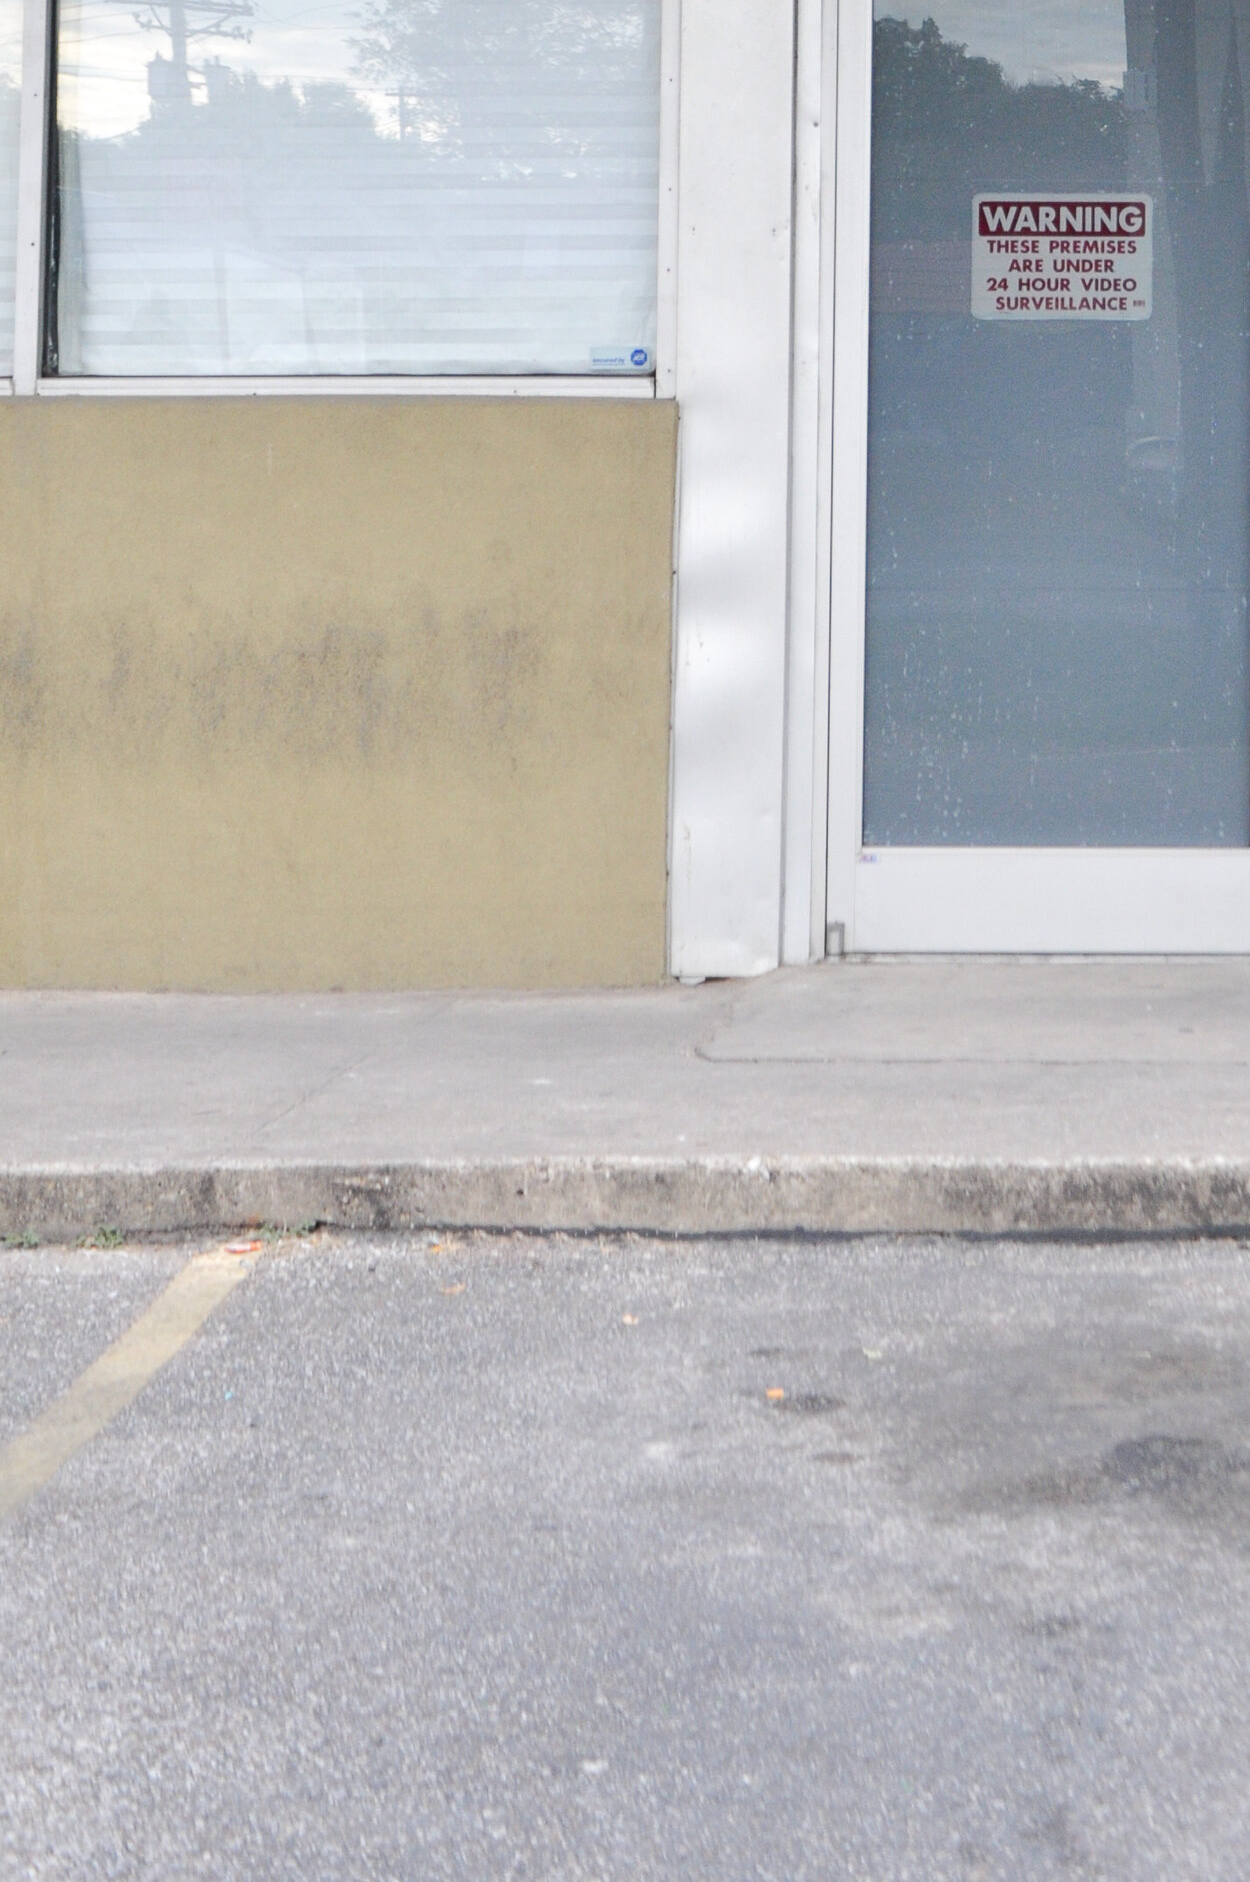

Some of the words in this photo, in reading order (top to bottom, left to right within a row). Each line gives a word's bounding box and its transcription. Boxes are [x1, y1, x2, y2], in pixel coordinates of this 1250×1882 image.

[982, 206, 1143, 233] WARNING
[987, 239, 1040, 254] THESE
[1049, 239, 1137, 254] PREMISES
[1008, 258, 1044, 273] ARE
[1053, 258, 1115, 273] UNDER
[986, 277, 1009, 292] 24
[1018, 277, 1071, 292] HOUR
[1080, 277, 1137, 292] VIDEO
[995, 296, 1128, 311] SURVEILLANCE
